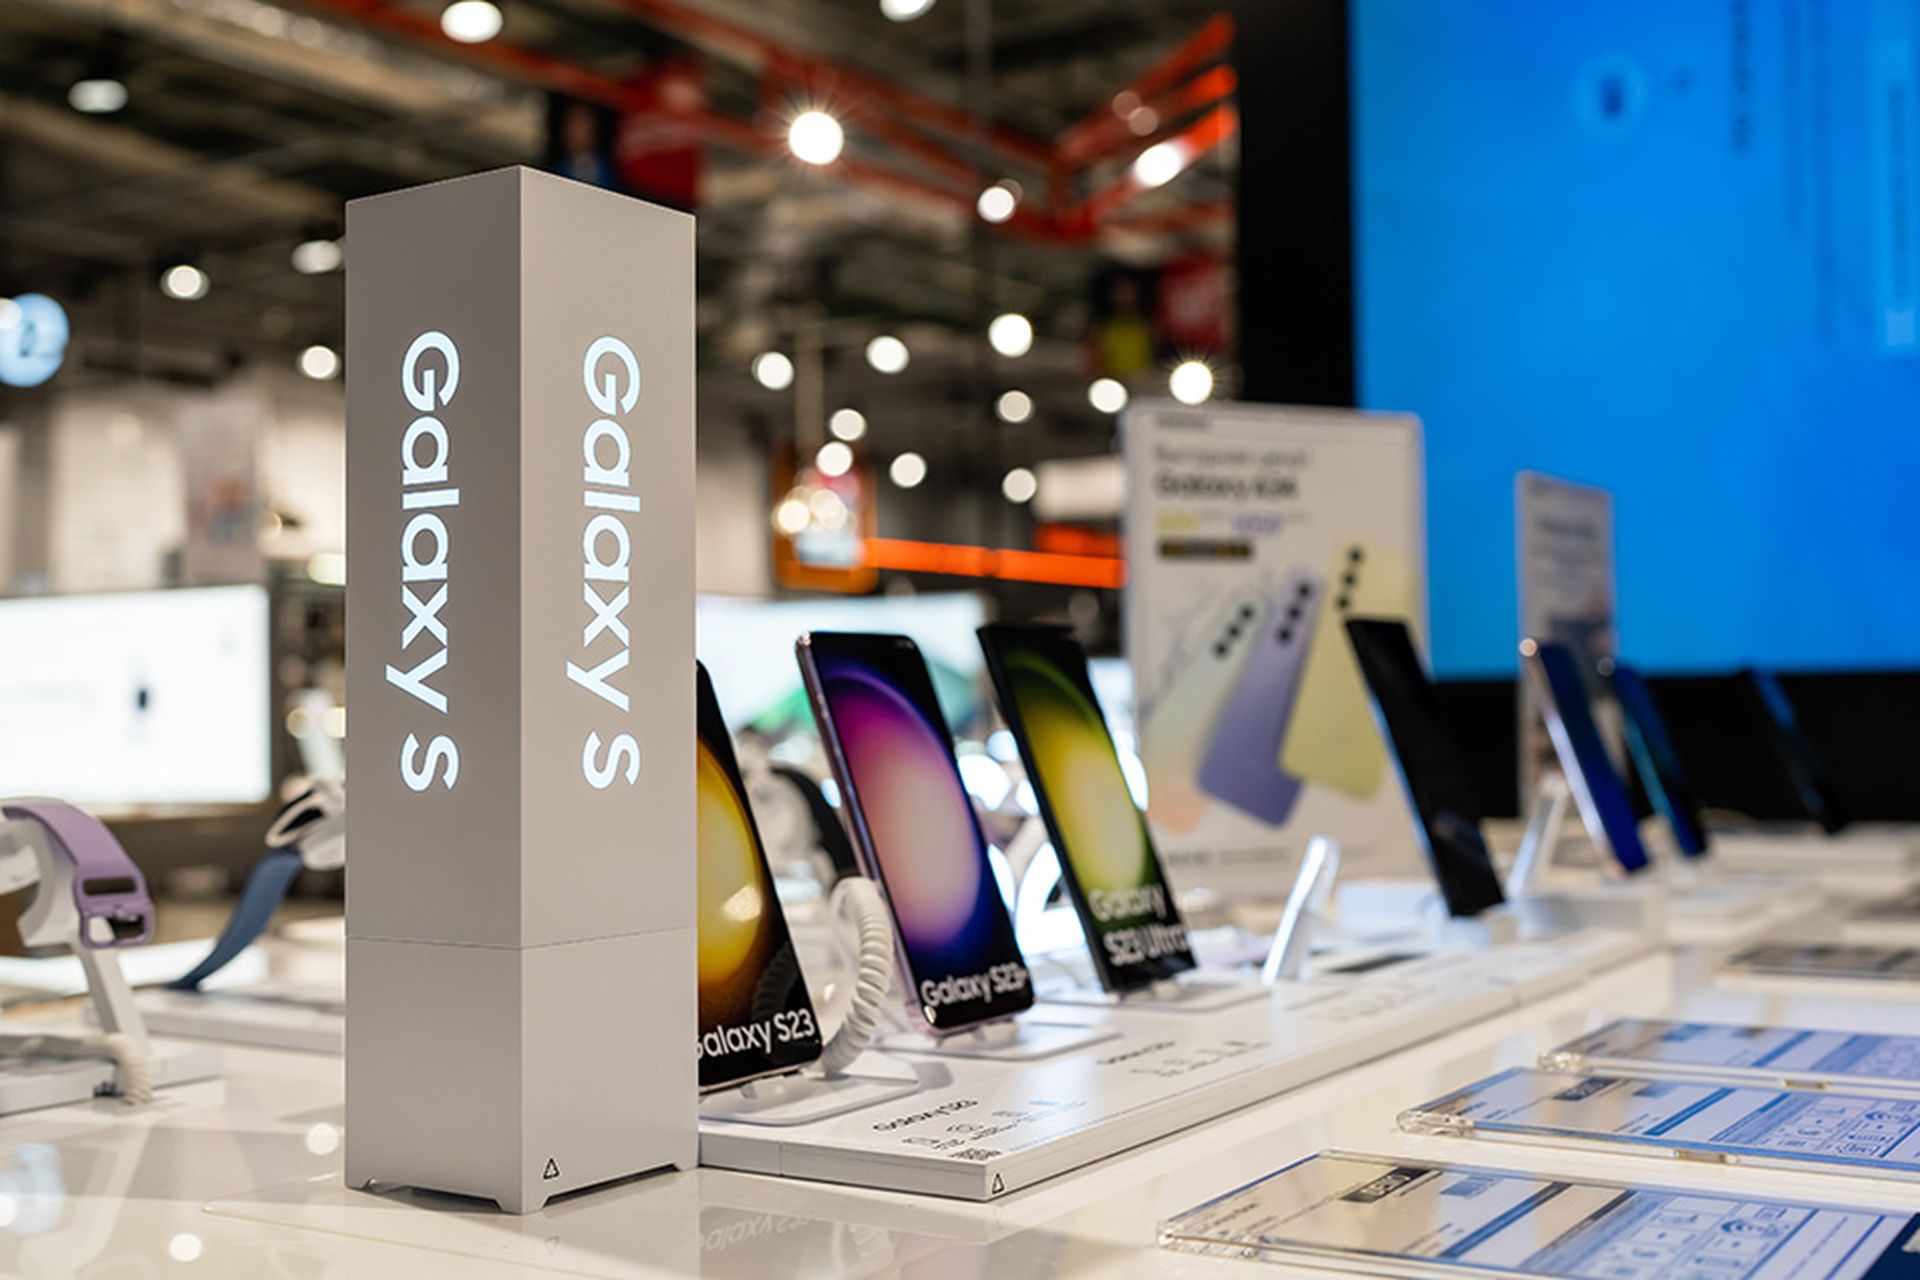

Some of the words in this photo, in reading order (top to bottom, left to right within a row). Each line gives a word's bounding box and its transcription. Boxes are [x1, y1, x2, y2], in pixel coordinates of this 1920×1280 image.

[386, 332, 459, 713] Galaxy
[567, 337, 640, 711] Galaxy
[402, 733, 458, 791] S
[583, 732, 639, 788] S
[1088, 885, 1168, 921] Galaxy
[1103, 928, 1146, 966] S23
[921, 975, 993, 1007] Galaxy
[772, 1008, 815, 1042] S23
